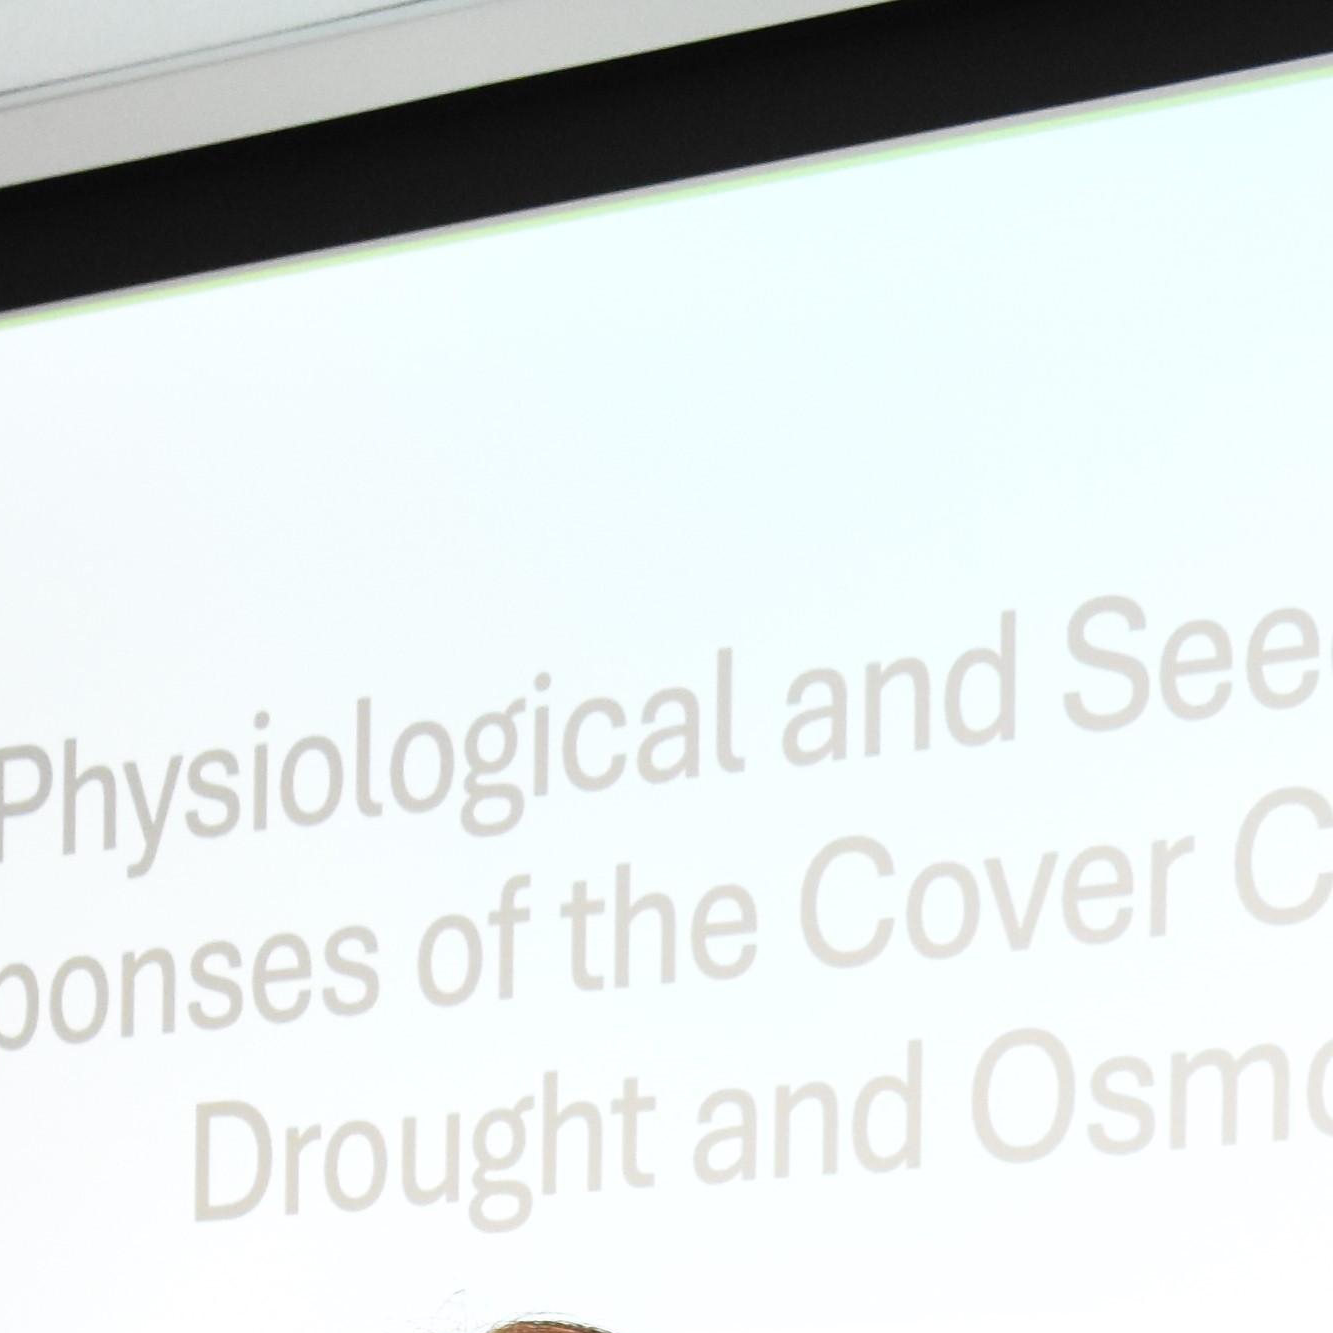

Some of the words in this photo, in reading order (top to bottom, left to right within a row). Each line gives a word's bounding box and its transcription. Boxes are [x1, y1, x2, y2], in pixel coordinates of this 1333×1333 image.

[782, 609, 1017, 767] and
[1063, 594, 1333, 733] See
[416, 874, 532, 1006] of
[559, 862, 757, 991] the
[799, 835, 1195, 969] Cover
[192, 1071, 657, 1233] Drought
[693, 1039, 923, 1184] and
